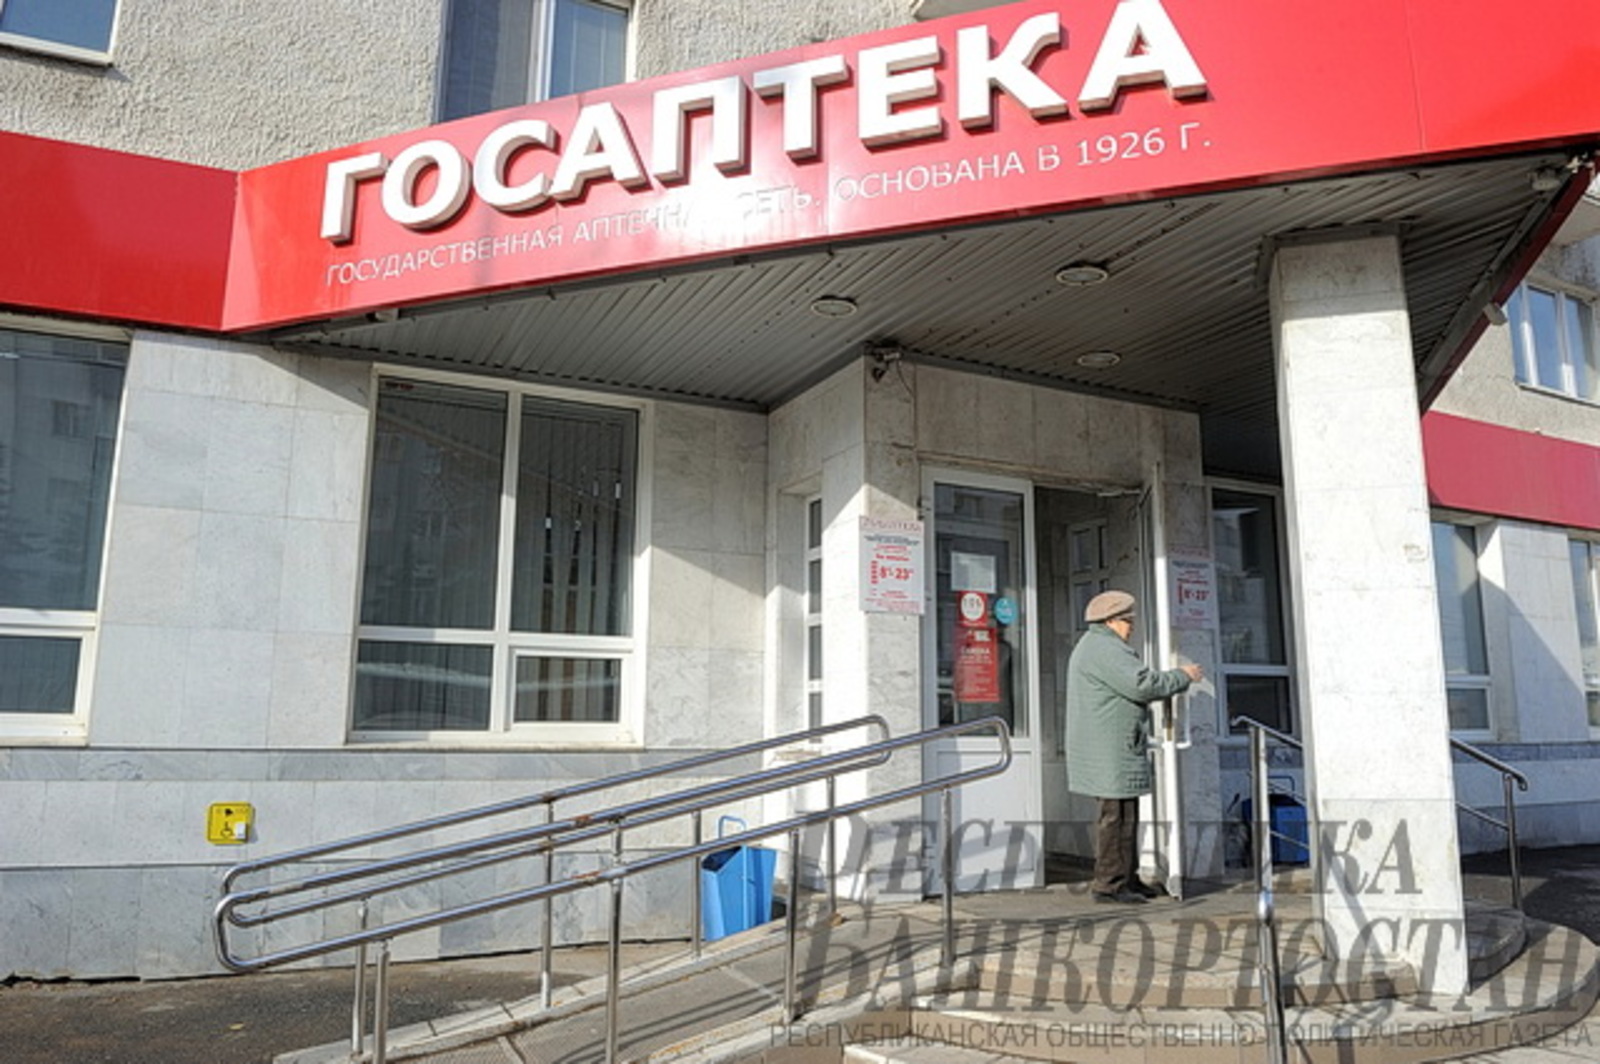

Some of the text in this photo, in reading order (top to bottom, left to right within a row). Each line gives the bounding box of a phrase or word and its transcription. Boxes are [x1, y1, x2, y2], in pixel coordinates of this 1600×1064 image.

[319, 0, 1209, 244] ГОСАПТЕКА
[325, 225, 563, 286] ГОСУДАРСТВЕННАЯ
[573, 197, 720, 243] АПТЕЧН
[832, 150, 1026, 200] ОСНОВАНА
[1037, 144, 1061, 171] В
[1077, 126, 1166, 165] 1926
[1179, 121, 1213, 150] Г.
